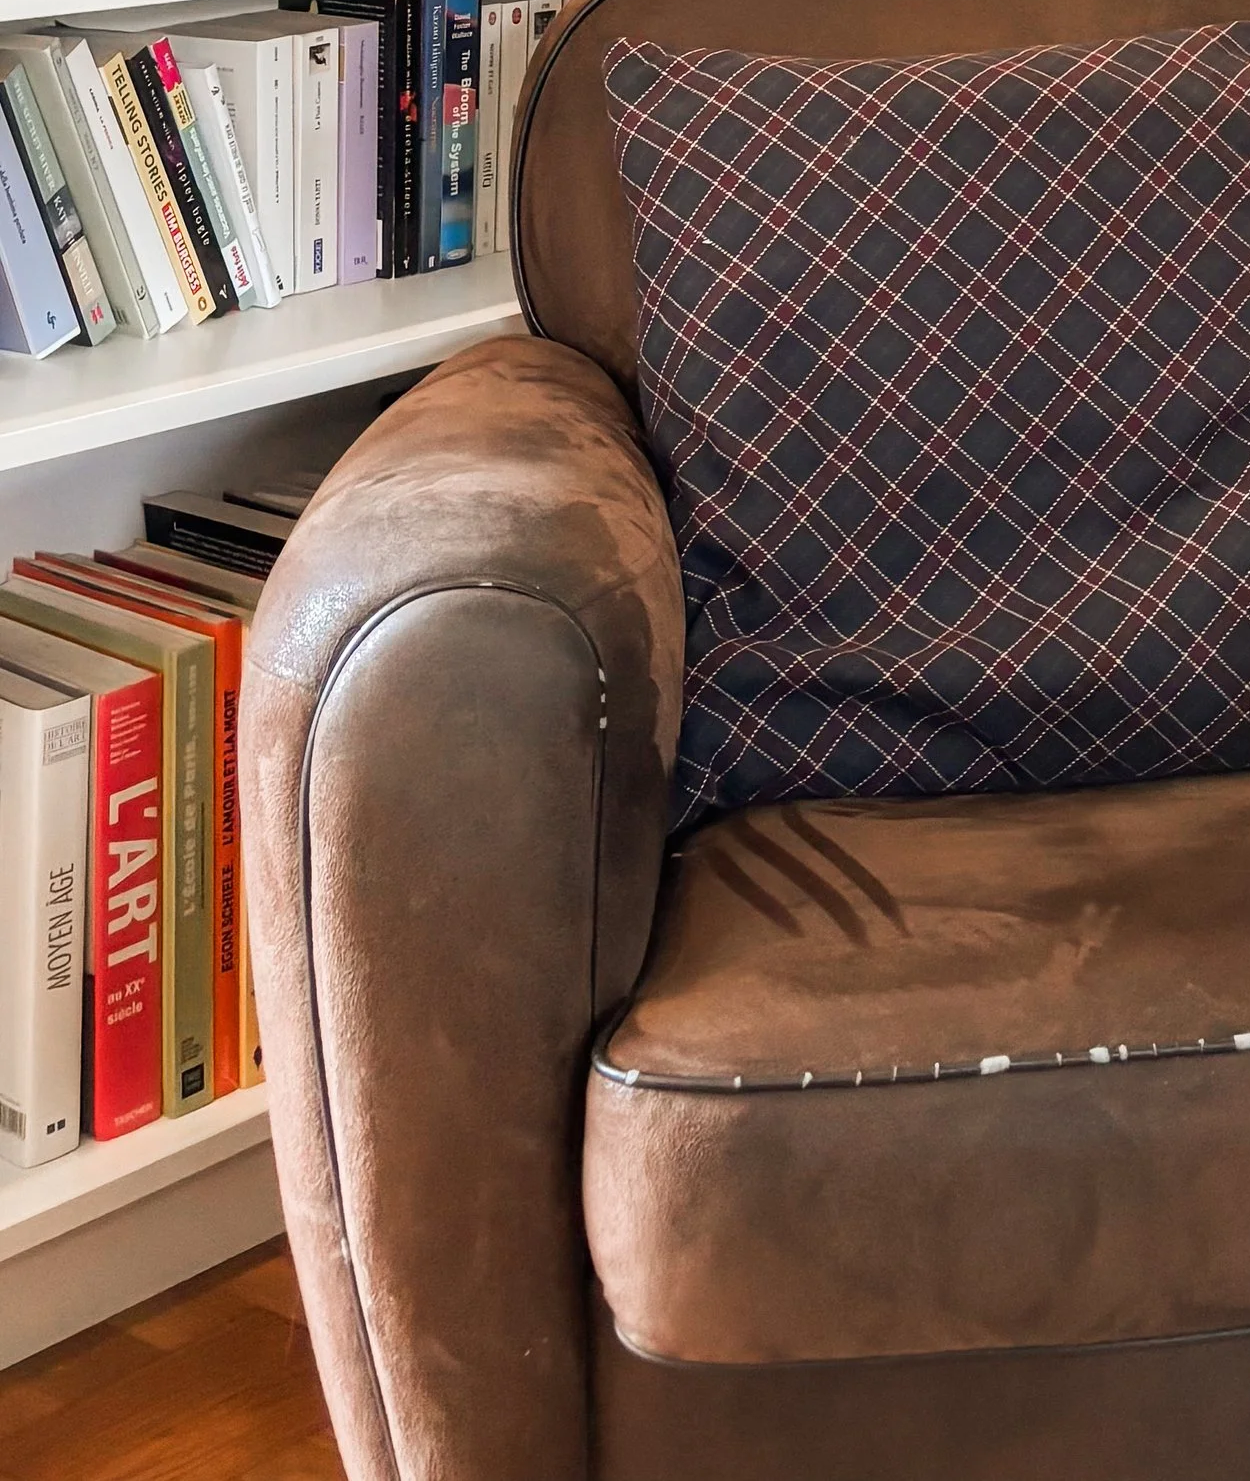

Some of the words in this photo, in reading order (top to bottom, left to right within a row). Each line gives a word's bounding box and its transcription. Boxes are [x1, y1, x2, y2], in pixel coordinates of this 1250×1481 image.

[431, 5, 441, 40] Kazuo
[429, 43, 440, 89] Ishiguro
[460, 50, 471, 71] The
[452, 106, 460, 118] of
[459, 77, 472, 125] Broom
[451, 121, 460, 139] the
[110, 63, 142, 135] TELLING
[136, 134, 168, 203] STORIES
[162, 206, 178, 233] TIM
[173, 232, 201, 291] BURGESS
[449, 143, 461, 196] System
[44, 862, 75, 907] ÂGE
[107, 775, 159, 969] L'ART
[46, 911, 74, 992] MOYEN
